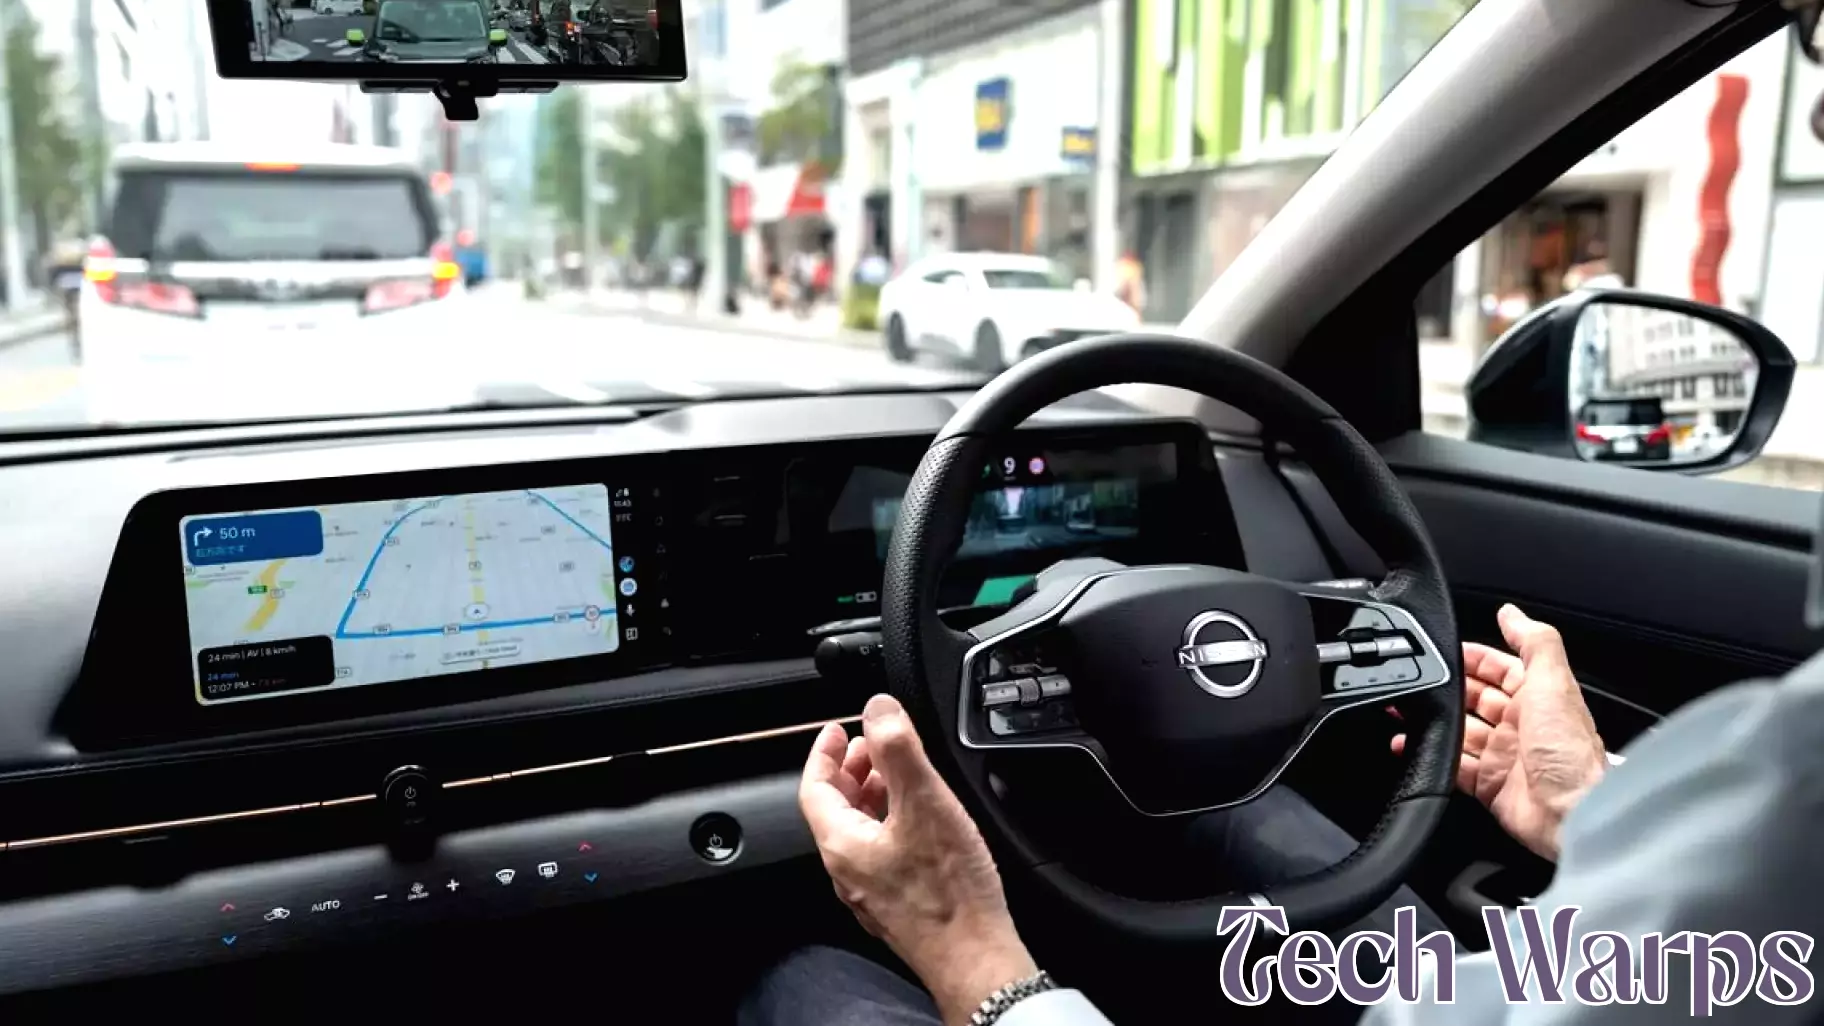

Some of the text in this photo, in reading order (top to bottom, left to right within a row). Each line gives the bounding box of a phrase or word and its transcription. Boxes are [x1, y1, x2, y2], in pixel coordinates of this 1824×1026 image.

[1004, 456, 1016, 475] 9
[219, 526, 256, 540] 50 m
[207, 653, 220, 663] 24
[221, 651, 241, 661] min
[234, 681, 250, 689] PM
[311, 900, 340, 912] AUTO
